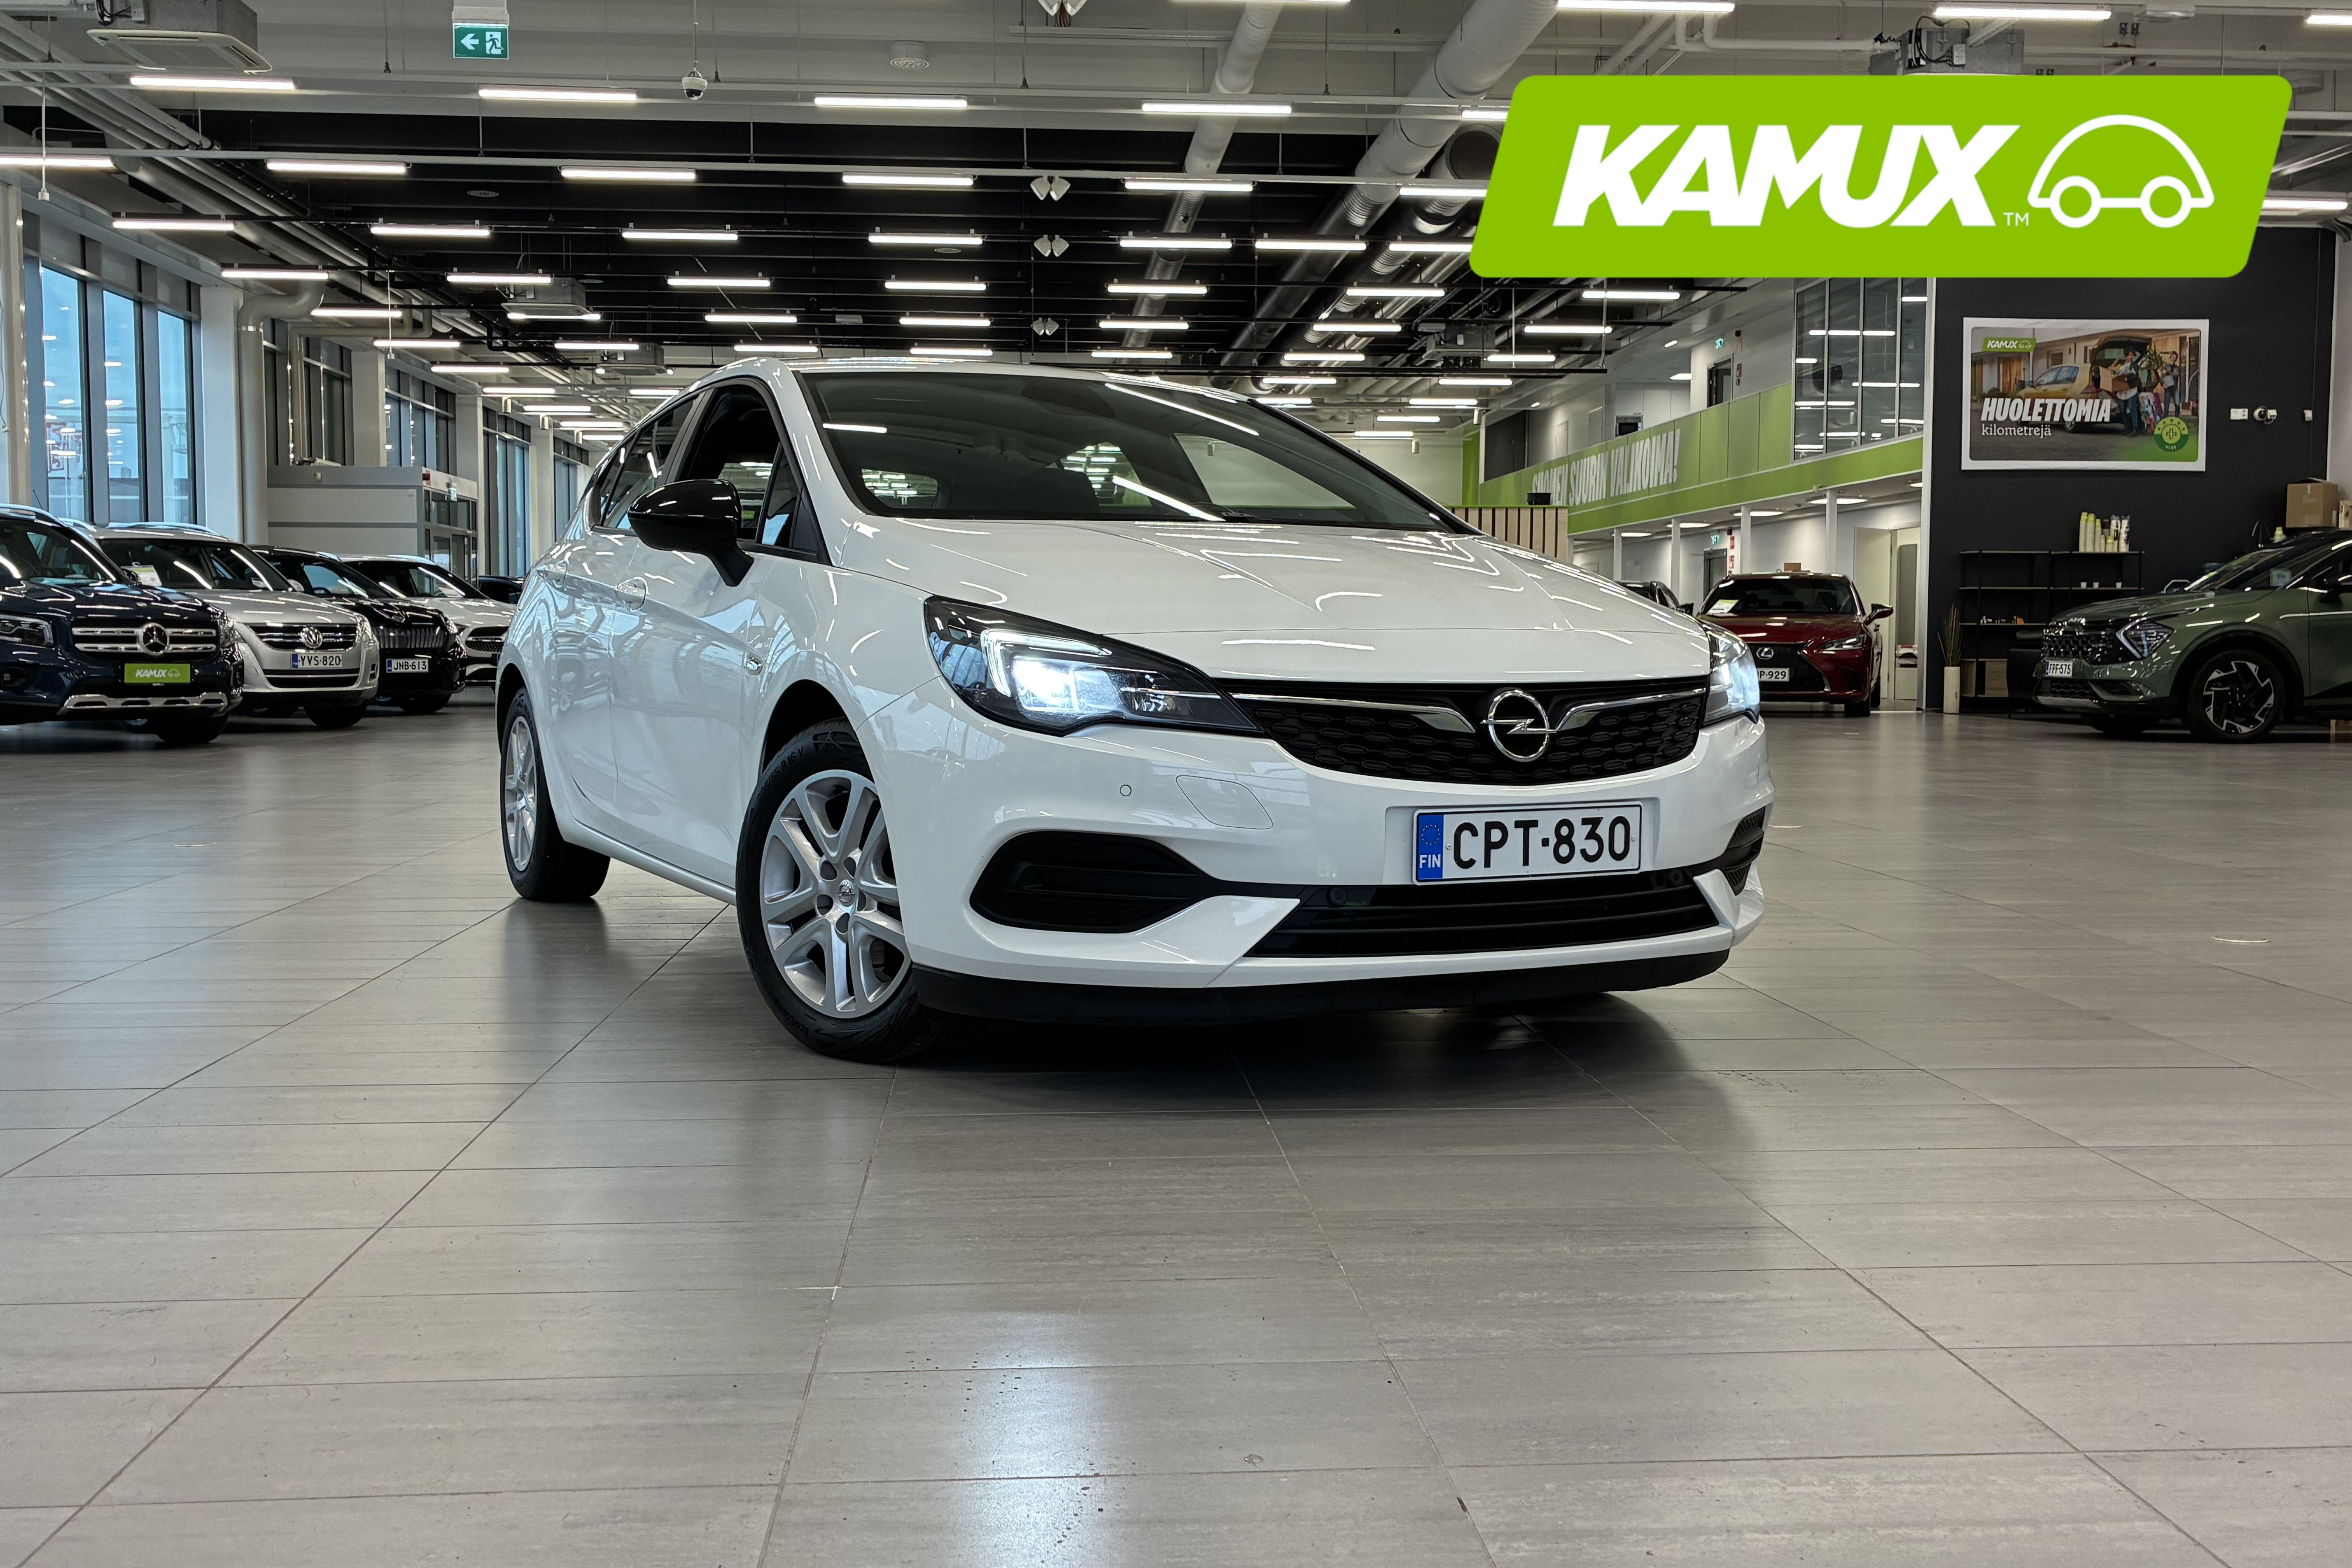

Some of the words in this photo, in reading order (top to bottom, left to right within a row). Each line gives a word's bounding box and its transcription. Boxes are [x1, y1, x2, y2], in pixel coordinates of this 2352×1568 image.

[1987, 340, 2018, 348] KAMUX
[1981, 397, 2111, 422] HUOLETTOMIA
[1981, 424, 2052, 439] kilometrejä
[1568, 452, 1609, 507] SUURIN
[1610, 429, 1681, 497] VALIKOIMA!
[300, 656, 341, 666] YVS-820
[393, 660, 427, 671] JNB-613
[135, 669, 168, 678] KAMUX
[1758, 670, 1787, 679] P-929
[1453, 815, 1631, 869] CPT-830
[1419, 854, 1441, 868] FIN
